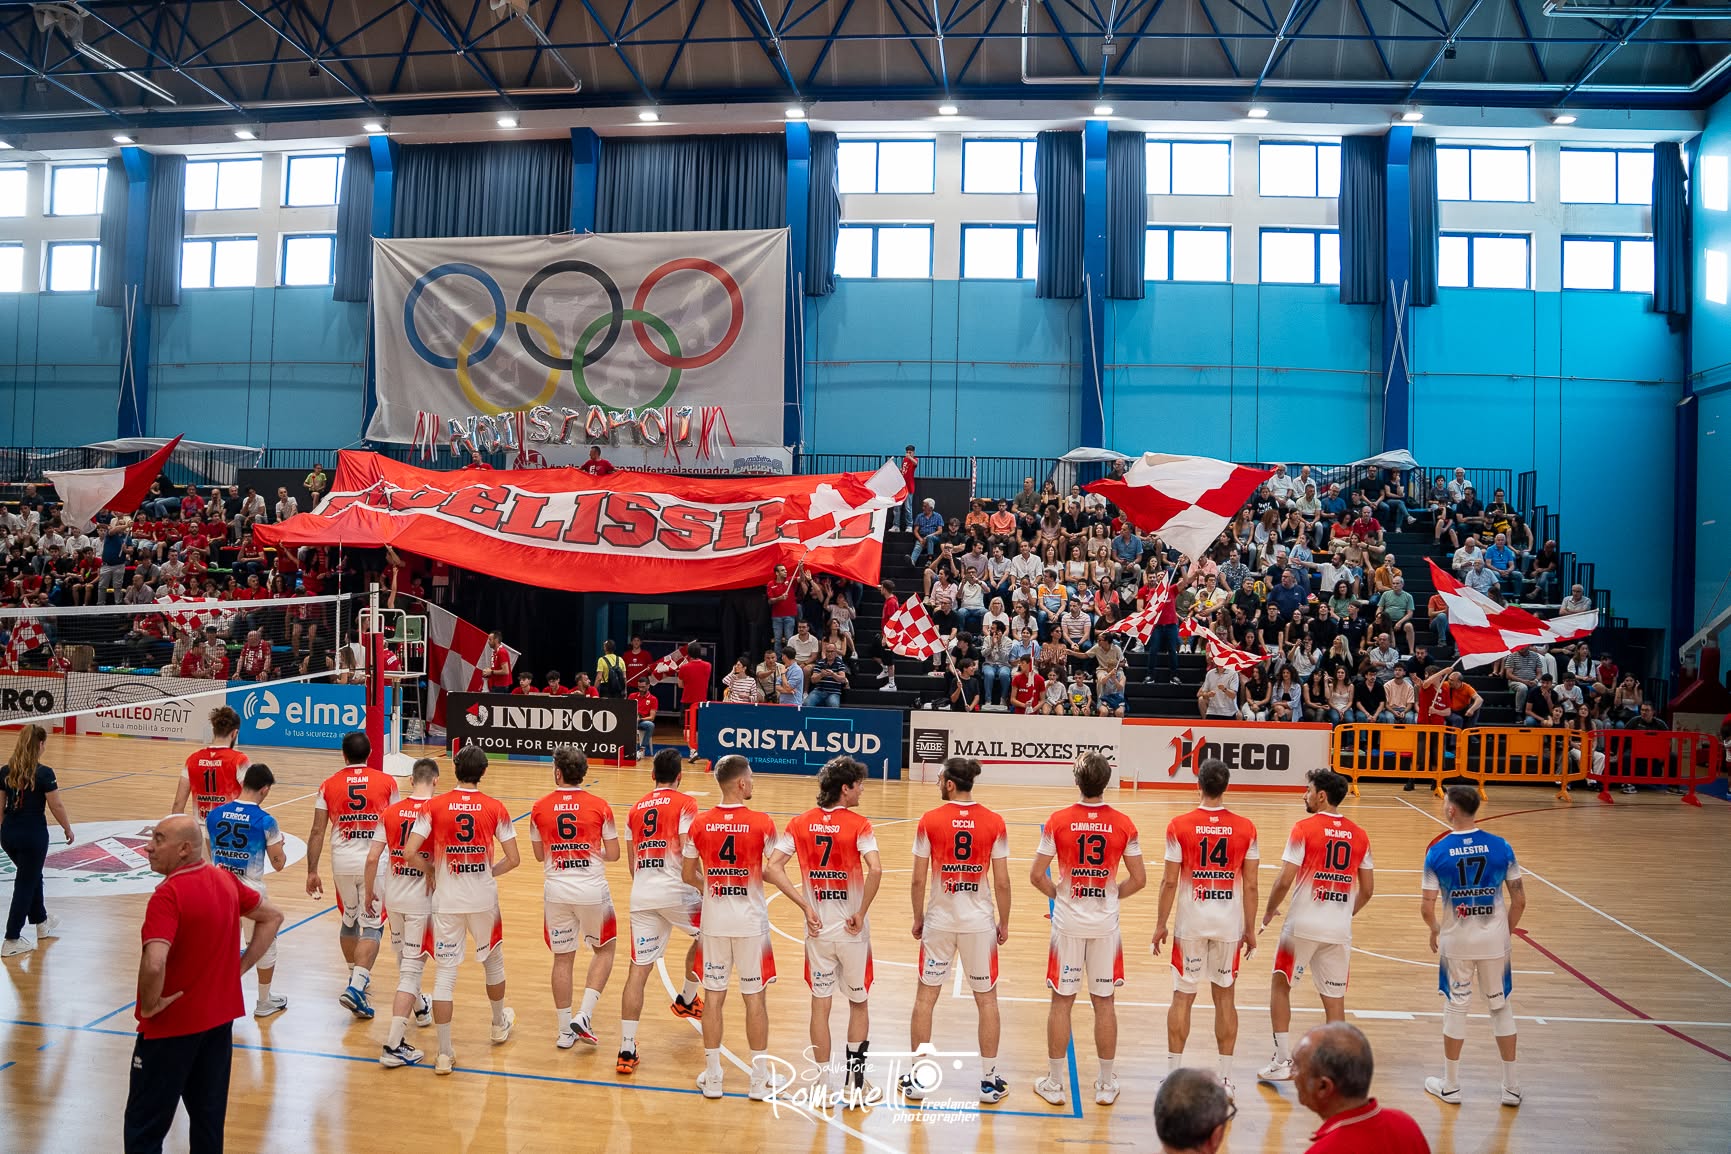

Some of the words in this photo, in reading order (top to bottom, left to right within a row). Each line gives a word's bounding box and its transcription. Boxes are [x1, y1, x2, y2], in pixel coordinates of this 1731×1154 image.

[154, 707, 192, 724] RENT
[491, 705, 618, 733] INDECO
[101, 721, 110, 729] La
[112, 722, 125, 730] tua
[127, 722, 158, 732] mobilità
[160, 726, 183, 734] smart
[306, 730, 337, 738] sicurezza
[465, 736, 473, 747] A
[477, 737, 512, 748] TOOL
[516, 739, 542, 750] FOR
[547, 741, 588, 752] EVERY
[592, 743, 618, 753] JOB
[718, 727, 881, 754] CRISTALSUD
[920, 741, 942, 752] MBE
[954, 740, 1007, 758] MAIL
[1011, 742, 1073, 760] BOXES
[754, 757, 798, 765] TRASPARENTI
[203, 769, 217, 793] 11
[348, 784, 367, 811] 5
[448, 803, 482, 811] AUCIELLO
[553, 803, 580, 812] AIELLO
[455, 813, 475, 843] 3
[557, 812, 577, 840] 6
[643, 808, 658, 838] 9
[705, 823, 749, 833] CAPPELLUTI
[952, 819, 975, 829] CICCIA
[1070, 822, 1113, 833] CIAVARELLA
[1195, 825, 1233, 835] RUGGIERO
[215, 821, 250, 849] 25
[718, 834, 736, 864] 4
[815, 834, 833, 867] 7
[954, 830, 972, 861] 8
[1077, 833, 1107, 865] 13
[1199, 837, 1228, 867] 14
[1325, 839, 1351, 870] 10
[1449, 845, 1489, 857] BALESTRA
[942, 864, 982, 873] AMMERCO
[1456, 855, 1487, 886] 17
[1450, 888, 1496, 897] AMMERCO
